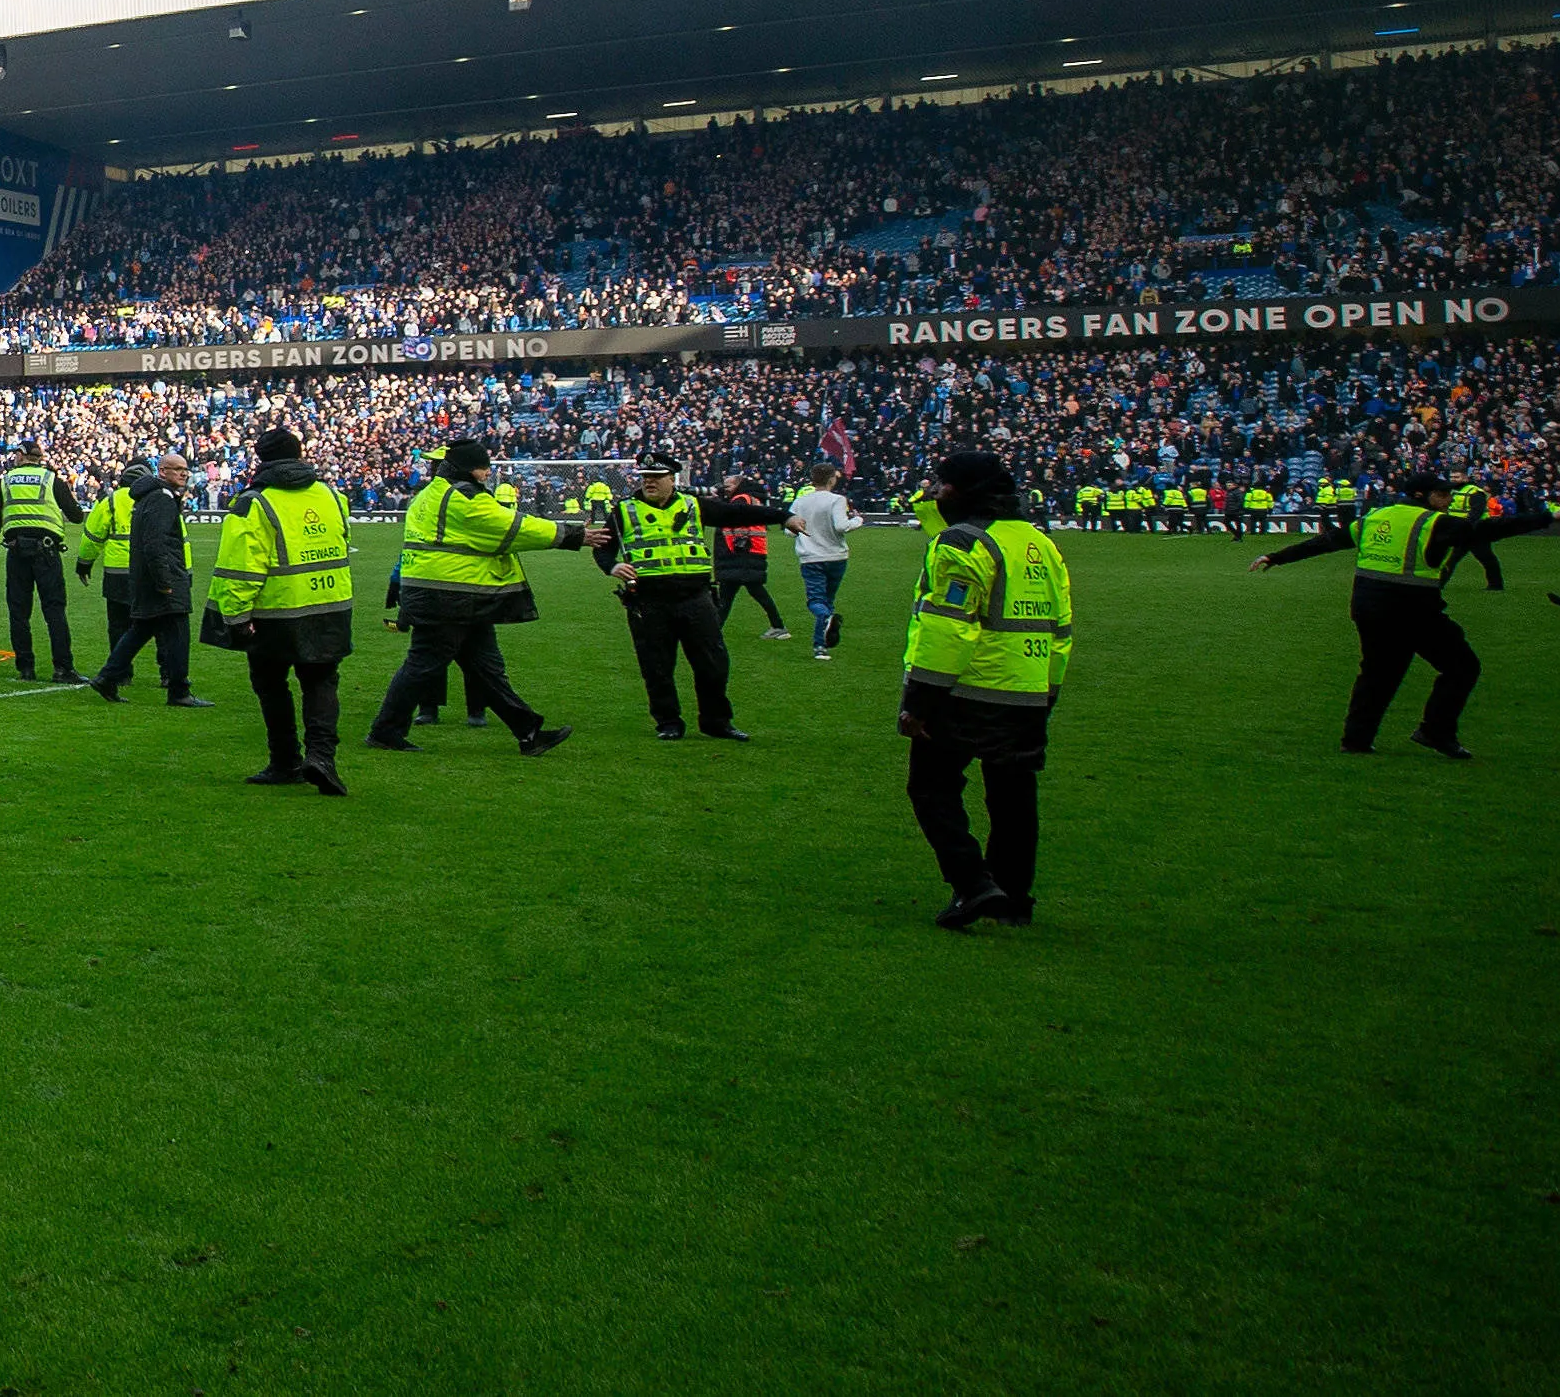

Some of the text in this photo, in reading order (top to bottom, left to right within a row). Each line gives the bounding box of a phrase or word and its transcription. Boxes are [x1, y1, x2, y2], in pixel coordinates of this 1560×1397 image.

[888, 296, 1510, 345] RANGERS FAN ZONE OPEN NO
[762, 332, 796, 340] MOTOR
[142, 348, 262, 373] RANGERS
[272, 346, 321, 369] FAN
[331, 344, 405, 366] ZONE
[507, 337, 548, 360] NO
[10, 475, 40, 485] POLICE
[303, 522, 327, 536] ASG
[300, 547, 341, 562] STEWARD
[1023, 566, 1048, 580] ASG
[310, 575, 335, 590] 310
[1023, 639, 1048, 658] 333
